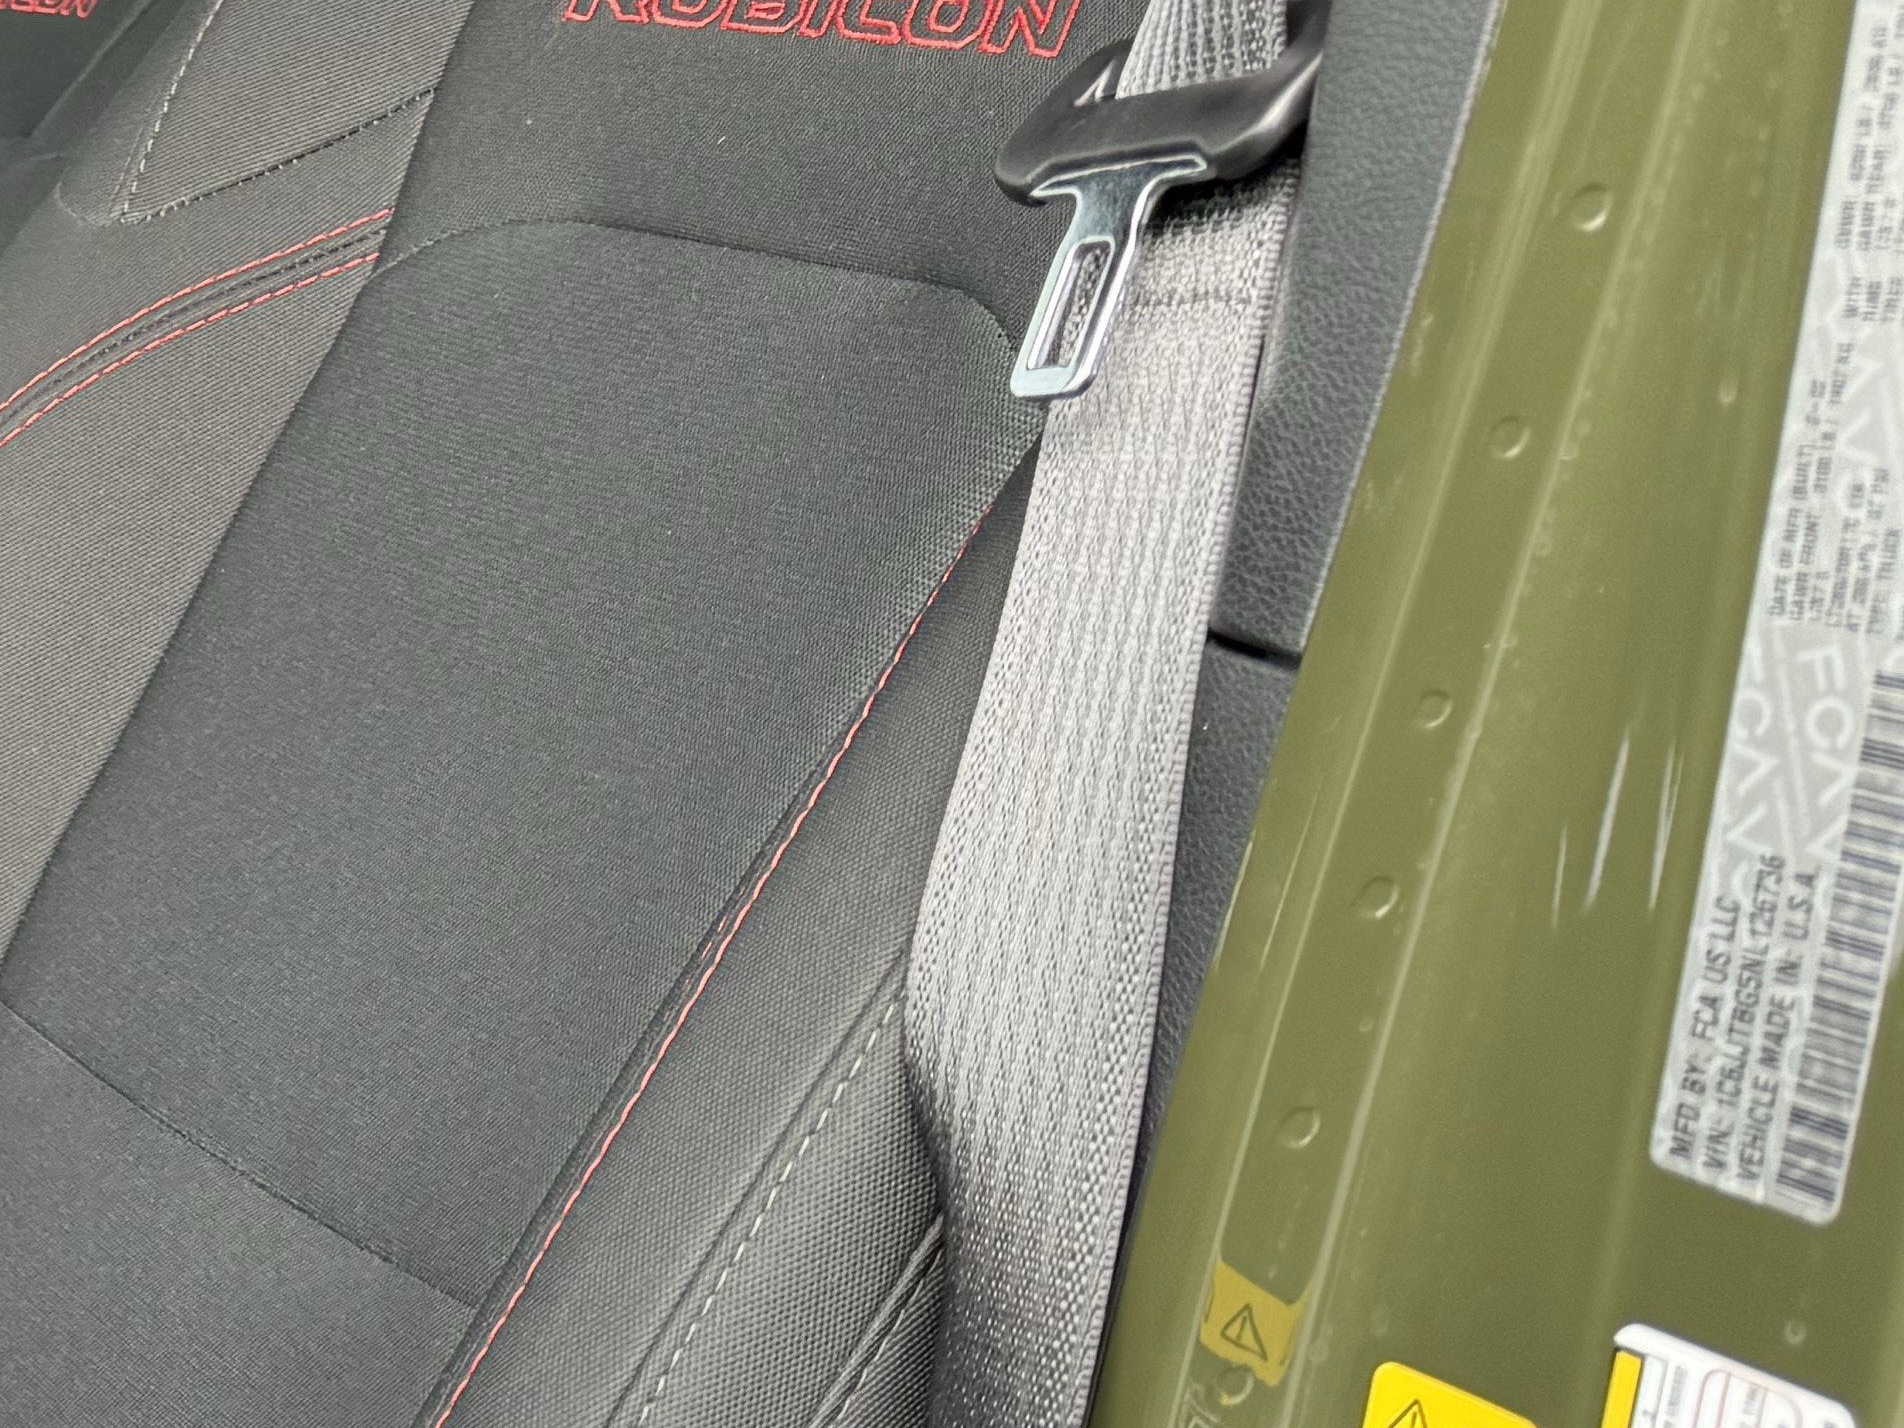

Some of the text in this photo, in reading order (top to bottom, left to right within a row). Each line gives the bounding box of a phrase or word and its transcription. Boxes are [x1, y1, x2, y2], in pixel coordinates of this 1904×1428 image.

[1709, 894, 1741, 943] LLC
[1701, 947, 1731, 986] US
[1690, 990, 1723, 1043] FCA
[1757, 991, 1795, 1071] MADE
[1668, 1100, 1702, 1161] MFD
[1735, 1073, 1780, 1184] VEHICLE
